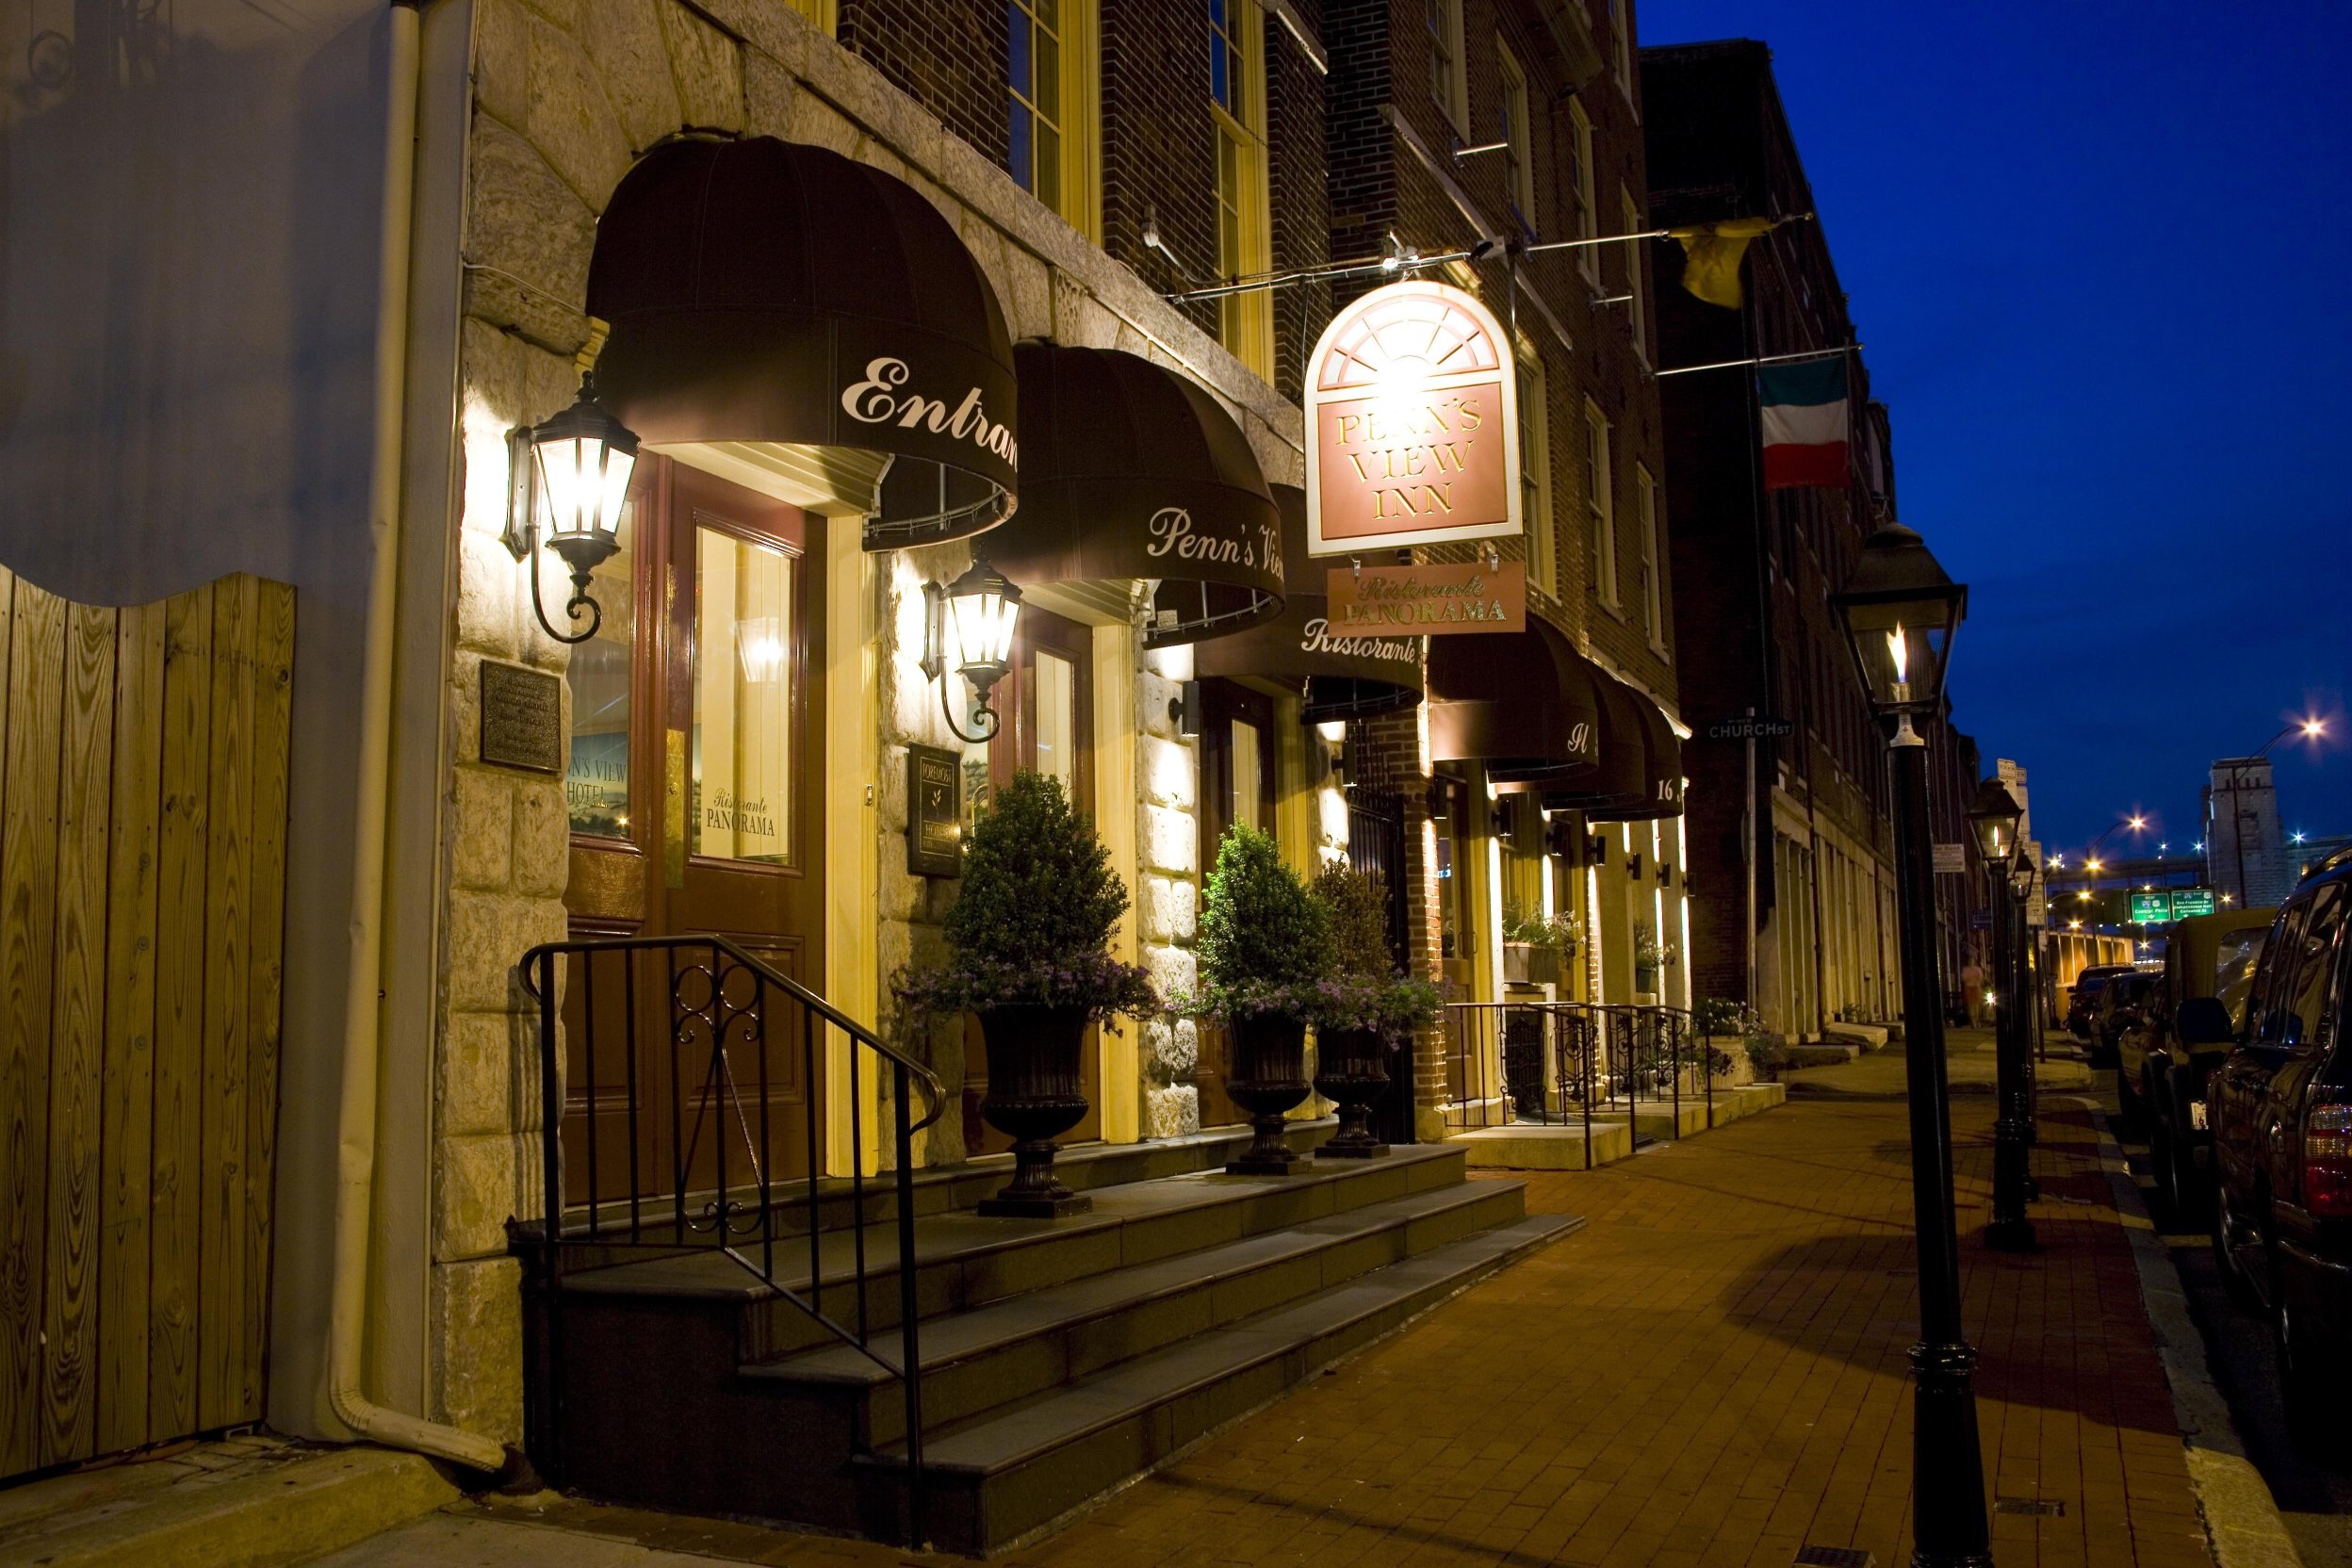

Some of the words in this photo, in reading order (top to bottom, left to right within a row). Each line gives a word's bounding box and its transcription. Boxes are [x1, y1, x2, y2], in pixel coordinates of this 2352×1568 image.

[1334, 398, 1481, 446] PEN'S
[1346, 439, 1476, 482] VIEW
[1372, 482, 1453, 520] INN
[1147, 507, 1255, 566] Penn's
[1357, 576, 1486, 601] Ristorante
[1343, 597, 1507, 626] PANORAMA
[1708, 723, 1776, 739] CHURCH
[1777, 725, 1790, 735] ST
[596, 760, 627, 784] VIEW
[923, 763, 952, 783] FOREMOST
[707, 808, 775, 837] PANORAMA
